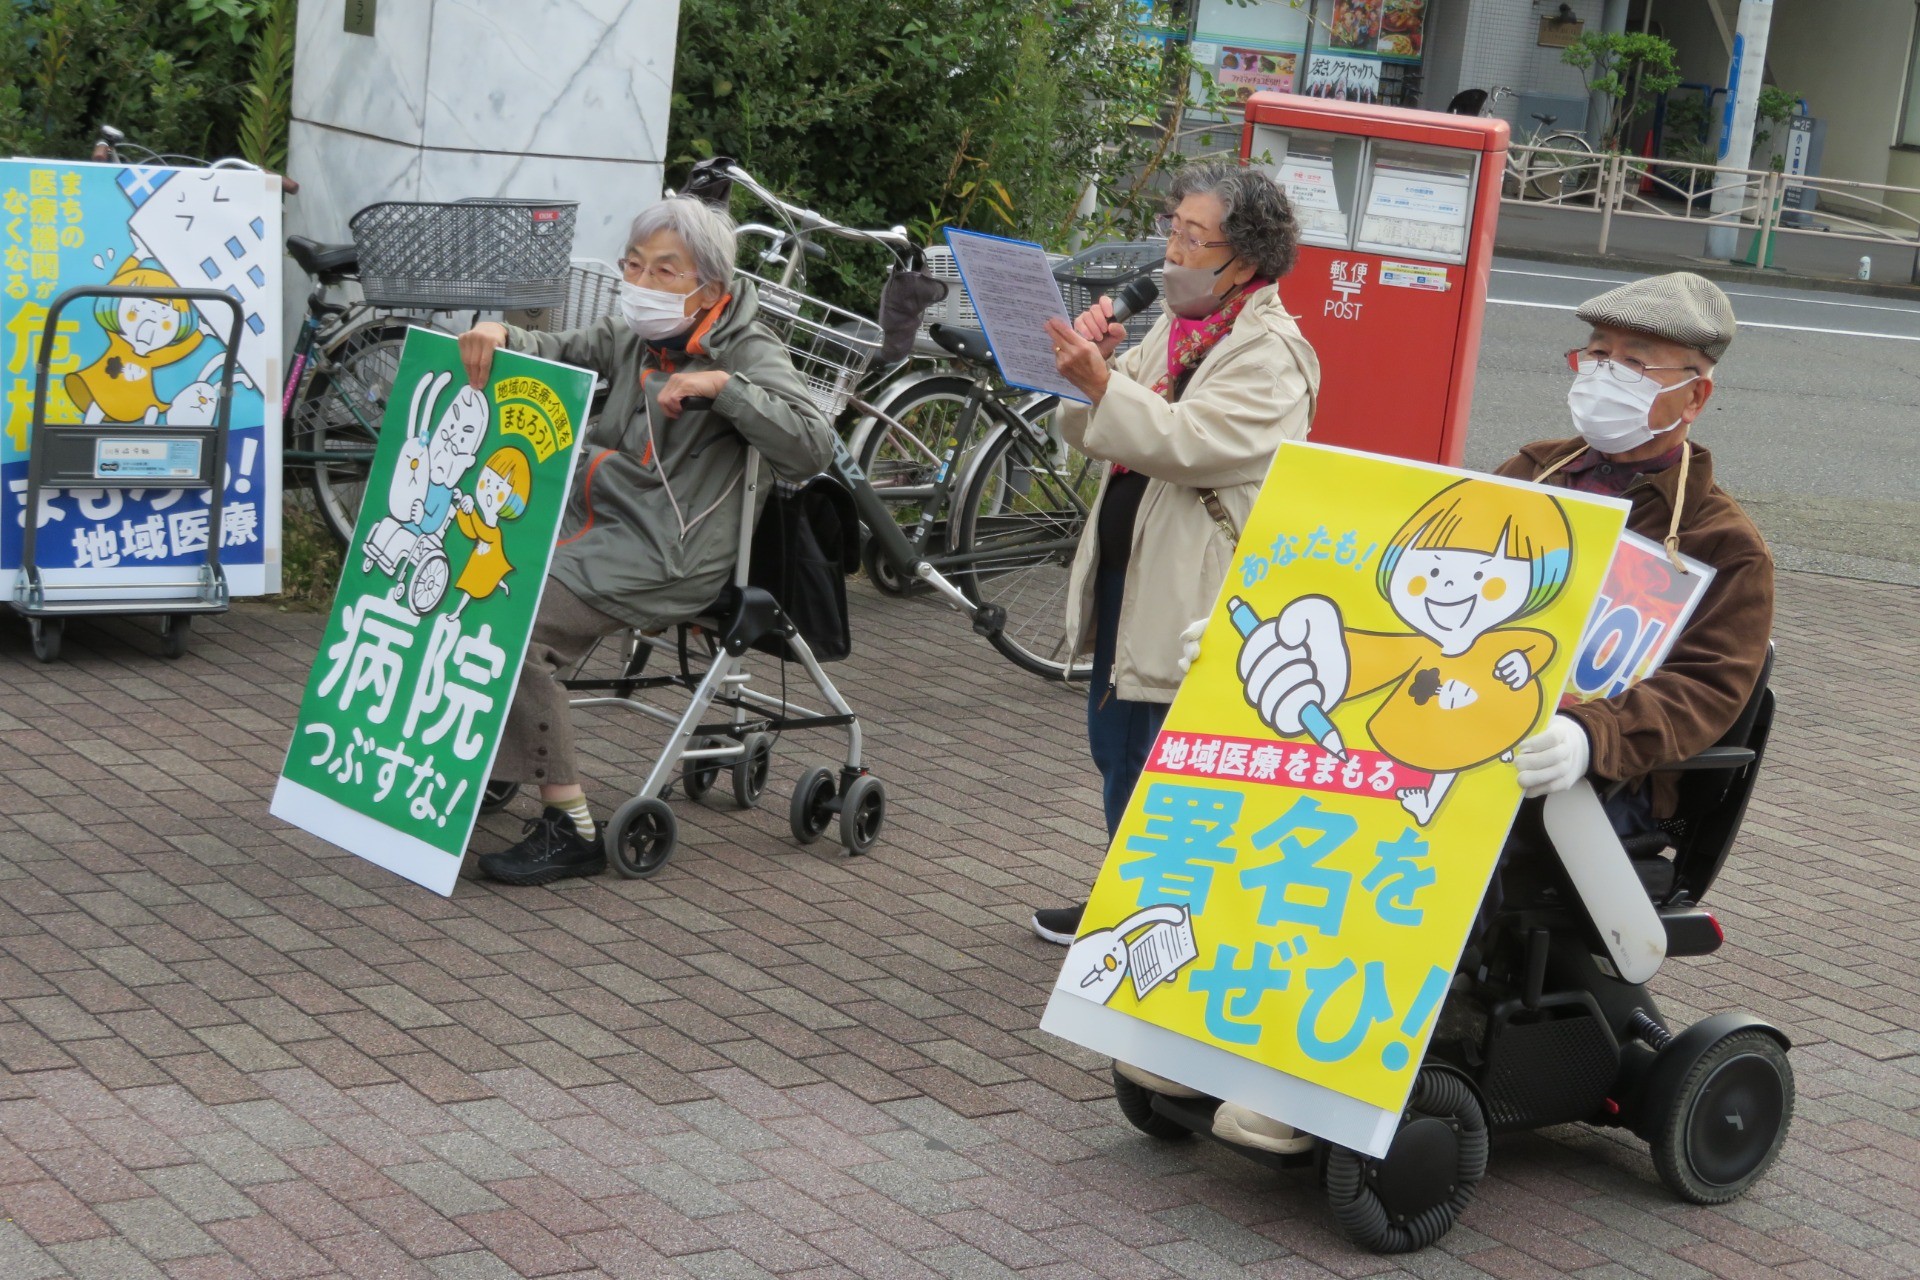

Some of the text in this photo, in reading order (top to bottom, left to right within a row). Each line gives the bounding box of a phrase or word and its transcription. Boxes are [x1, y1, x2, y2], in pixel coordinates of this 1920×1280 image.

[3, 187, 29, 299] なくなる
[30, 169, 59, 299] 医療機関が
[61, 171, 84, 248] まちの
[1324, 300, 1363, 320] POST
[1329, 260, 1368, 285] 郵便
[504, 406, 553, 454] まもろう!
[71, 501, 259, 568] 地域医療
[1238, 524, 1379, 589] あなたも!
[317, 588, 506, 761] 病院
[304, 722, 468, 828] つぶすな!
[1155, 736, 1397, 792] 地域医療をまもる
[1118, 782, 1437, 937] 署名を
[1188, 934, 1451, 1072] ぜひ!
